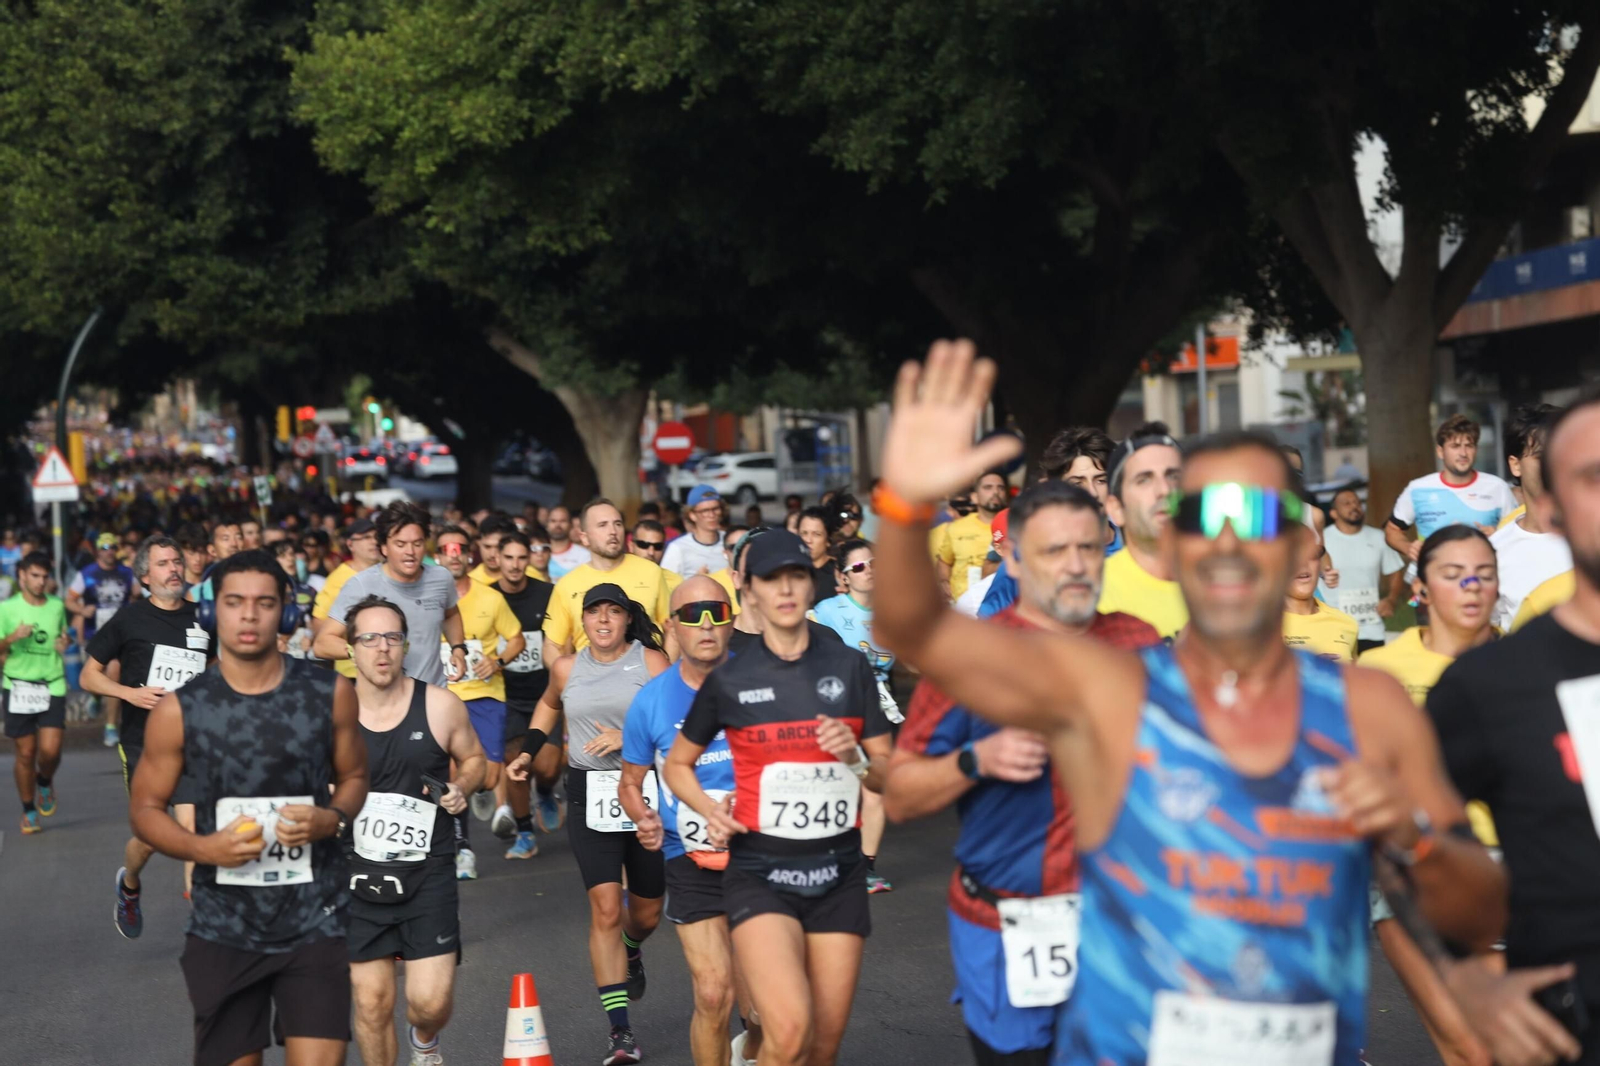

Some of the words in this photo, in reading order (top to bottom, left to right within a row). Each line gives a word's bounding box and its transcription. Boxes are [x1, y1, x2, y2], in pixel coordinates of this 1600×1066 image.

[771, 799, 848, 828] 7348
[360, 816, 428, 848] 10253
[808, 864, 839, 887] MAX
